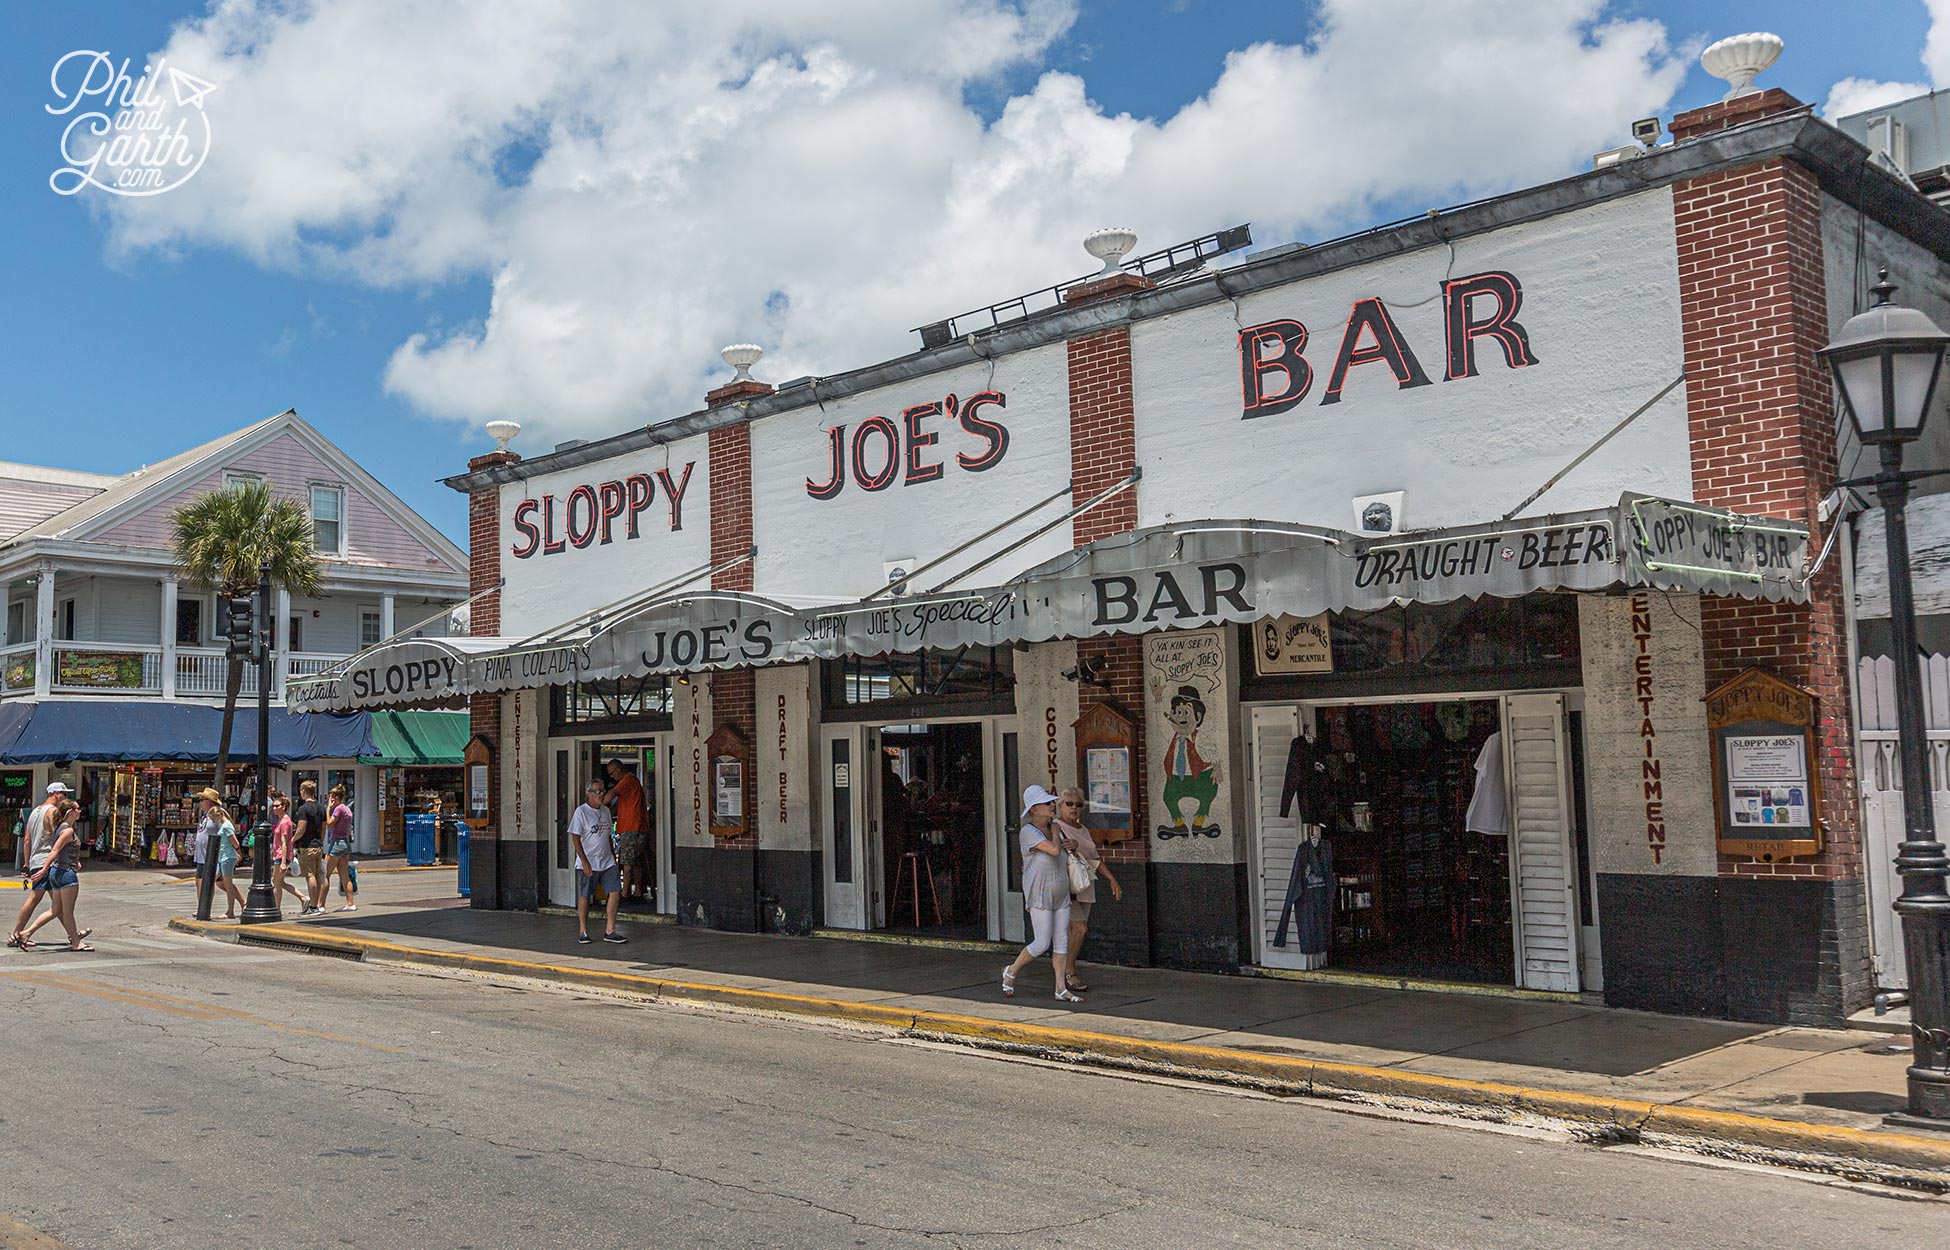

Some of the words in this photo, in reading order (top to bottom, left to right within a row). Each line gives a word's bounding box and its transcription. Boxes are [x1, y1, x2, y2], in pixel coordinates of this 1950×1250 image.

[512, 461, 696, 559] SLOPPY
[806, 390, 1010, 501] JOE'S
[1238, 270, 1539, 421] BAR
[1354, 540, 1501, 589] DRAUGHT
[1518, 525, 1609, 570] BEER
[1702, 524, 1745, 563] JOE'S
[1755, 532, 1792, 569] BAR
[1091, 562, 1256, 627] BAR
[641, 619, 773, 668] JOE'S
[804, 615, 848, 641] SLOPPY
[867, 608, 902, 636] JOE'S
[1170, 639, 1185, 650] KIN
[1187, 638, 1202, 649] SEE
[1203, 638, 1212, 647] IT
[1285, 622, 1310, 646] SLOPPY
[353, 656, 458, 699] SLOPPY
[1155, 653, 1169, 663] ALL
[1168, 658, 1195, 677] SLOPPY
[1290, 654, 1326, 663] MERCANTILE
[295, 680, 340, 702] Cocktails
[691, 685, 699, 738] PIÑA
[778, 695, 787, 761] DRAFT
[1046, 707, 1058, 797] COCKTA
[1631, 592, 1667, 864] ENTERTAINMENT
[1733, 739, 1771, 748] SLOPPY
[1772, 737, 1796, 747] JOE'S
[514, 692, 522, 835] ENTERTAINMENT
[693, 748, 701, 835] COLADAS
[779, 772, 788, 824] BEER
